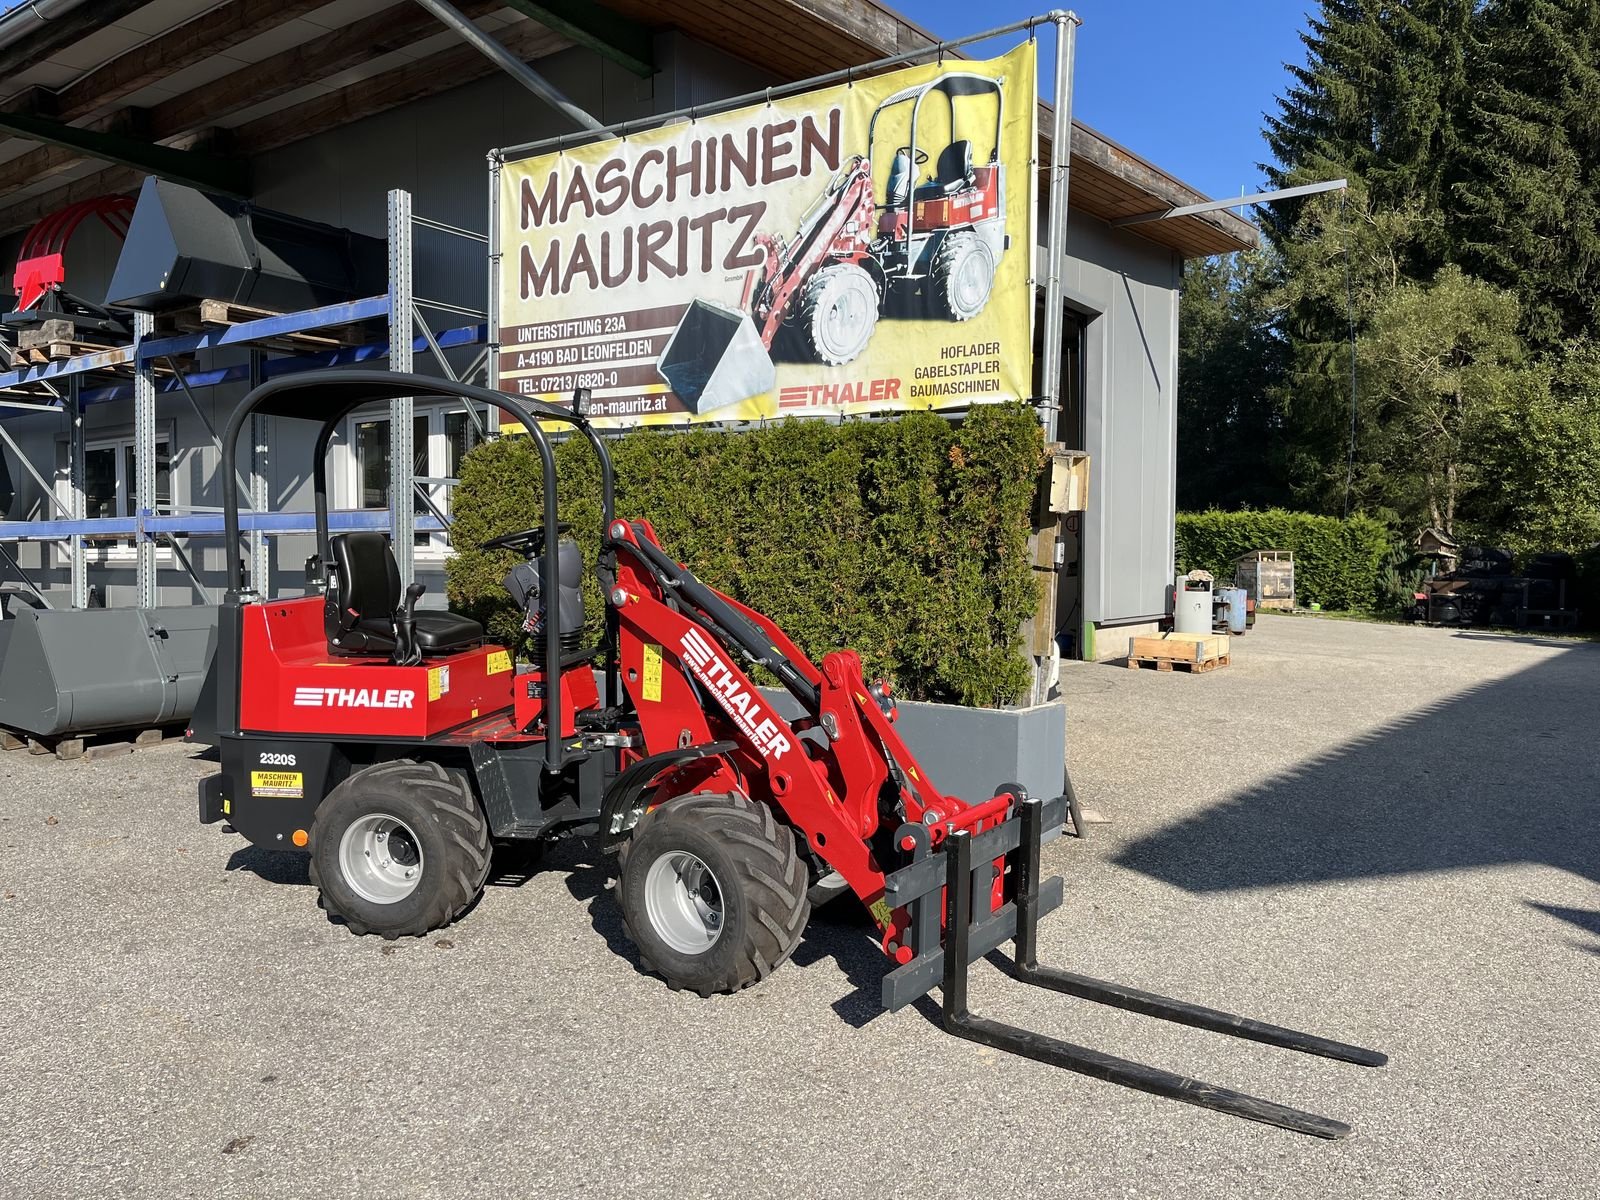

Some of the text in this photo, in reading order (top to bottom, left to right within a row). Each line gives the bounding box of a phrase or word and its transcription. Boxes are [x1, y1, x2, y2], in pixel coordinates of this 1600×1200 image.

[520, 108, 841, 230] MASCHINEN
[520, 201, 768, 300] MAURITZ
[518, 315, 626, 342] UNTERSTIFTUNG 23A
[517, 339, 652, 368] A-4190 BAD LEONFELDEN
[941, 342, 1000, 360] HOFLADER
[914, 360, 1000, 380] GABELSTAPLER
[518, 371, 618, 394] TEL: 07213/6820-0
[808, 378, 901, 406] THALER
[910, 379, 1000, 398] BAUMASCHINEN
[324, 688, 415, 709] THALER
[682, 651, 771, 757] www.maschinen-mauritz.at
[707, 656, 791, 761] THALER
[259, 752, 297, 766] 2320S
[257, 773, 298, 781] MASCHINEN
[262, 780, 293, 788] MAURITZ
